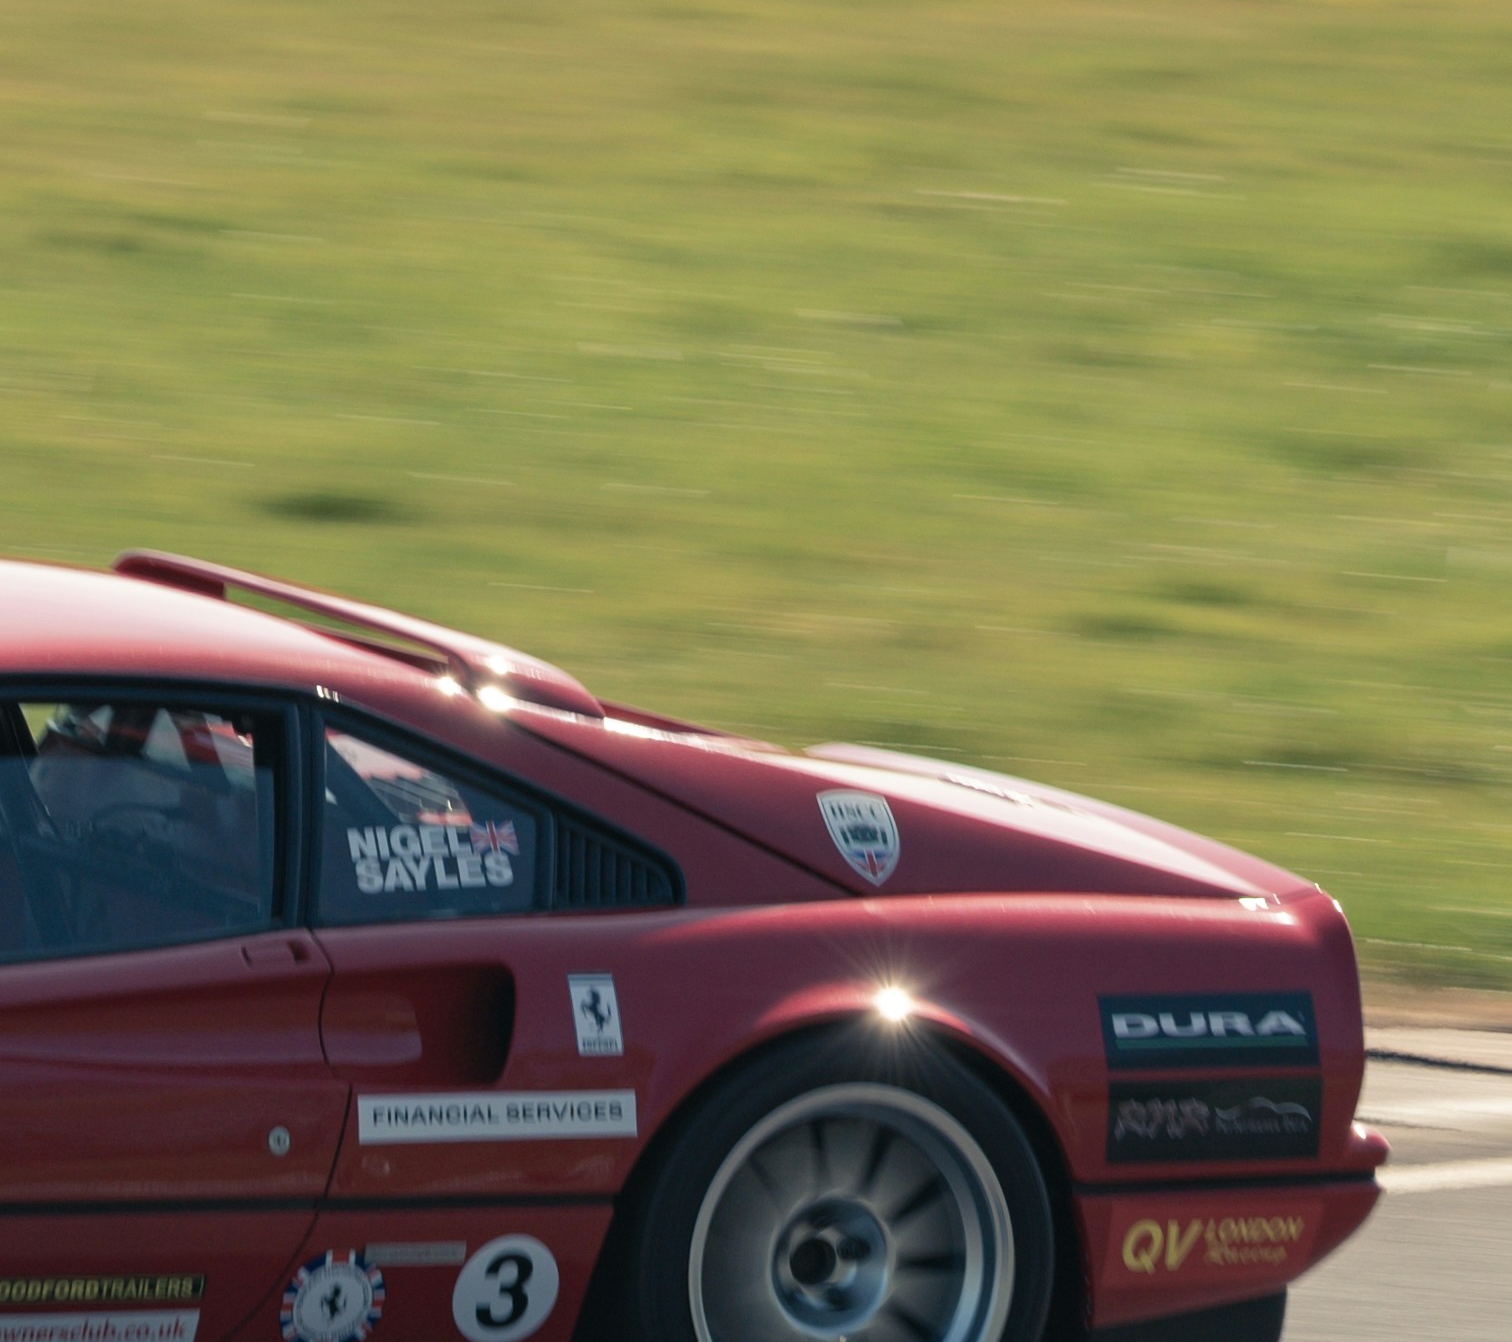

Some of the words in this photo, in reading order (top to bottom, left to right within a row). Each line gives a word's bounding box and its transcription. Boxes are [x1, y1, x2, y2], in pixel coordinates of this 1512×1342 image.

[347, 824, 474, 863] NIGEL
[355, 852, 514, 895] SAYLES
[1110, 1010, 1307, 1039] DURA
[372, 1102, 500, 1128] FINANCIAL
[506, 1099, 625, 1125] SERVICES
[1122, 1218, 1204, 1276] QV
[1204, 1215, 1305, 1247] LONDON
[475, 1249, 534, 1331] 3
